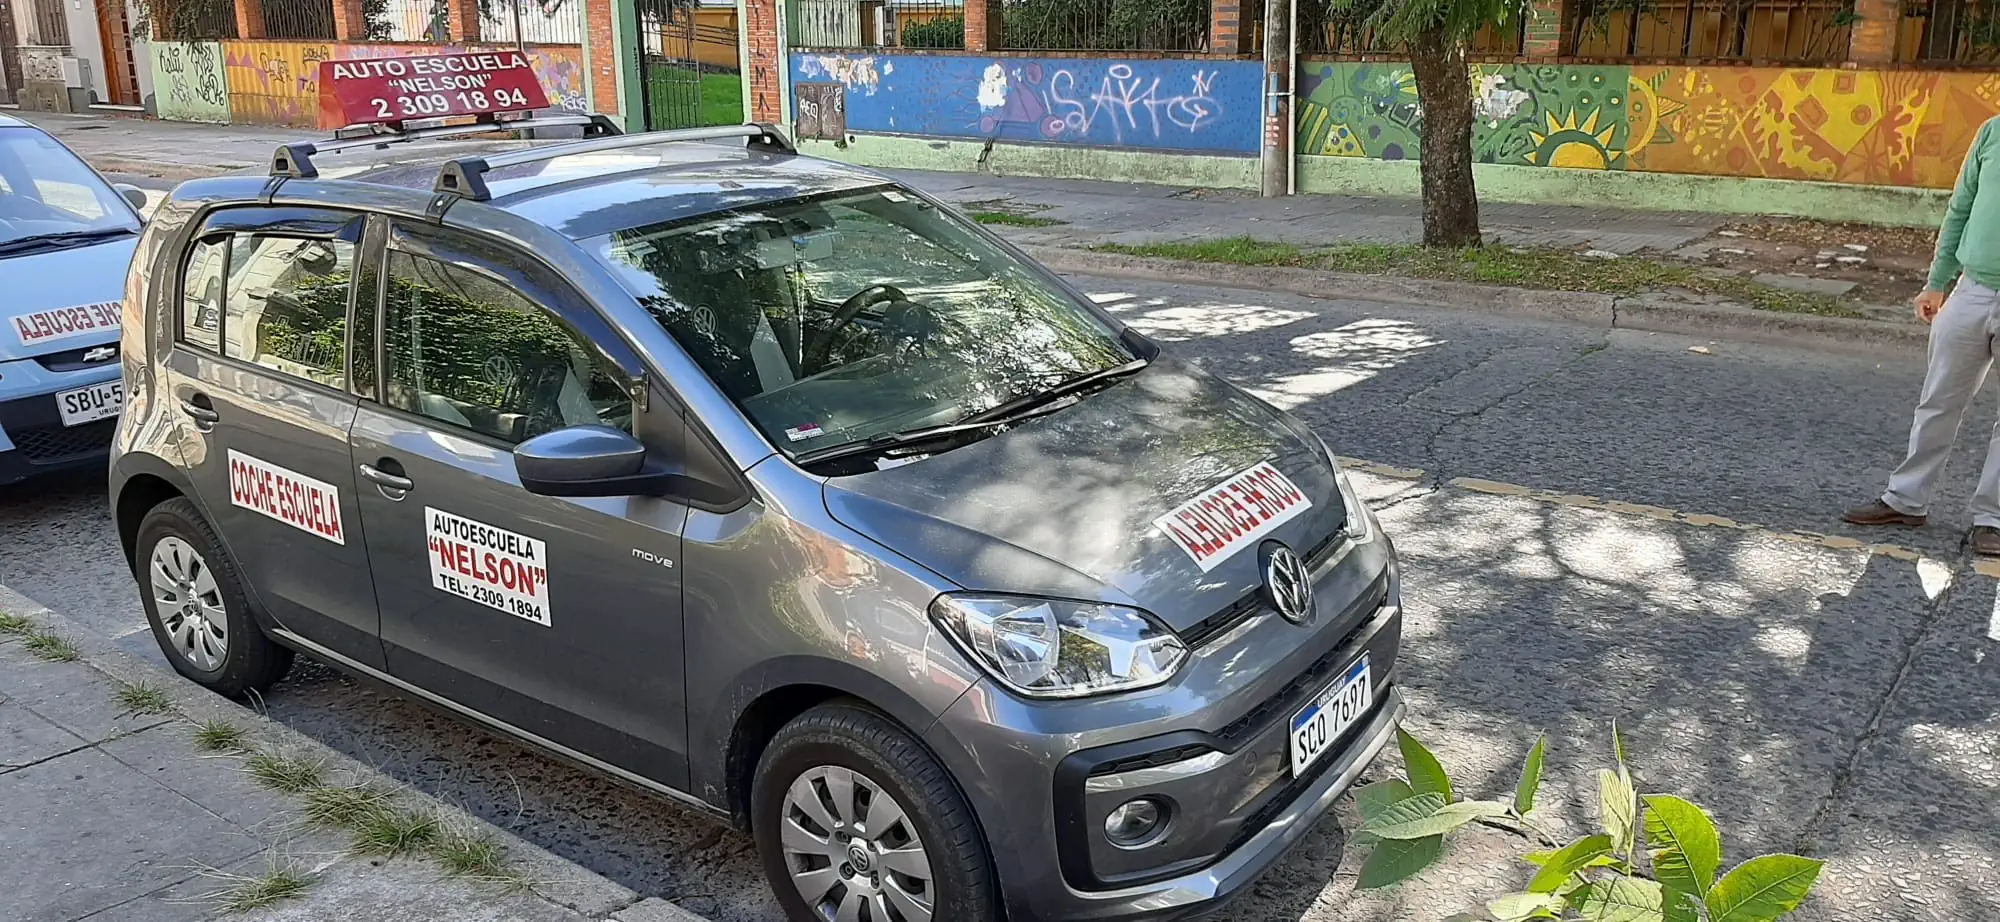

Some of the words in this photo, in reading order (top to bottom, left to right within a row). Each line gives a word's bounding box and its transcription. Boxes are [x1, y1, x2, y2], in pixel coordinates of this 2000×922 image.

[333, 60, 406, 80] AUTO
[415, 54, 528, 75] ESCUELA
[371, 98, 393, 118] 2
[402, 93, 449, 116] 309
[457, 90, 489, 110] 18
[494, 88, 528, 107] 94
[232, 458, 277, 514] COCHE
[276, 474, 342, 540] ESCUELA
[434, 513, 535, 560] AUTOESCUELA
[632, 548, 673, 568] move
[440, 573, 468, 596] TEL:
[472, 584, 504, 608] 2309
[508, 597, 542, 621] 1894
[1317, 674, 1347, 708] URUGUAY
[1298, 713, 1326, 764] SCO
[1332, 675, 1366, 732] 7697
